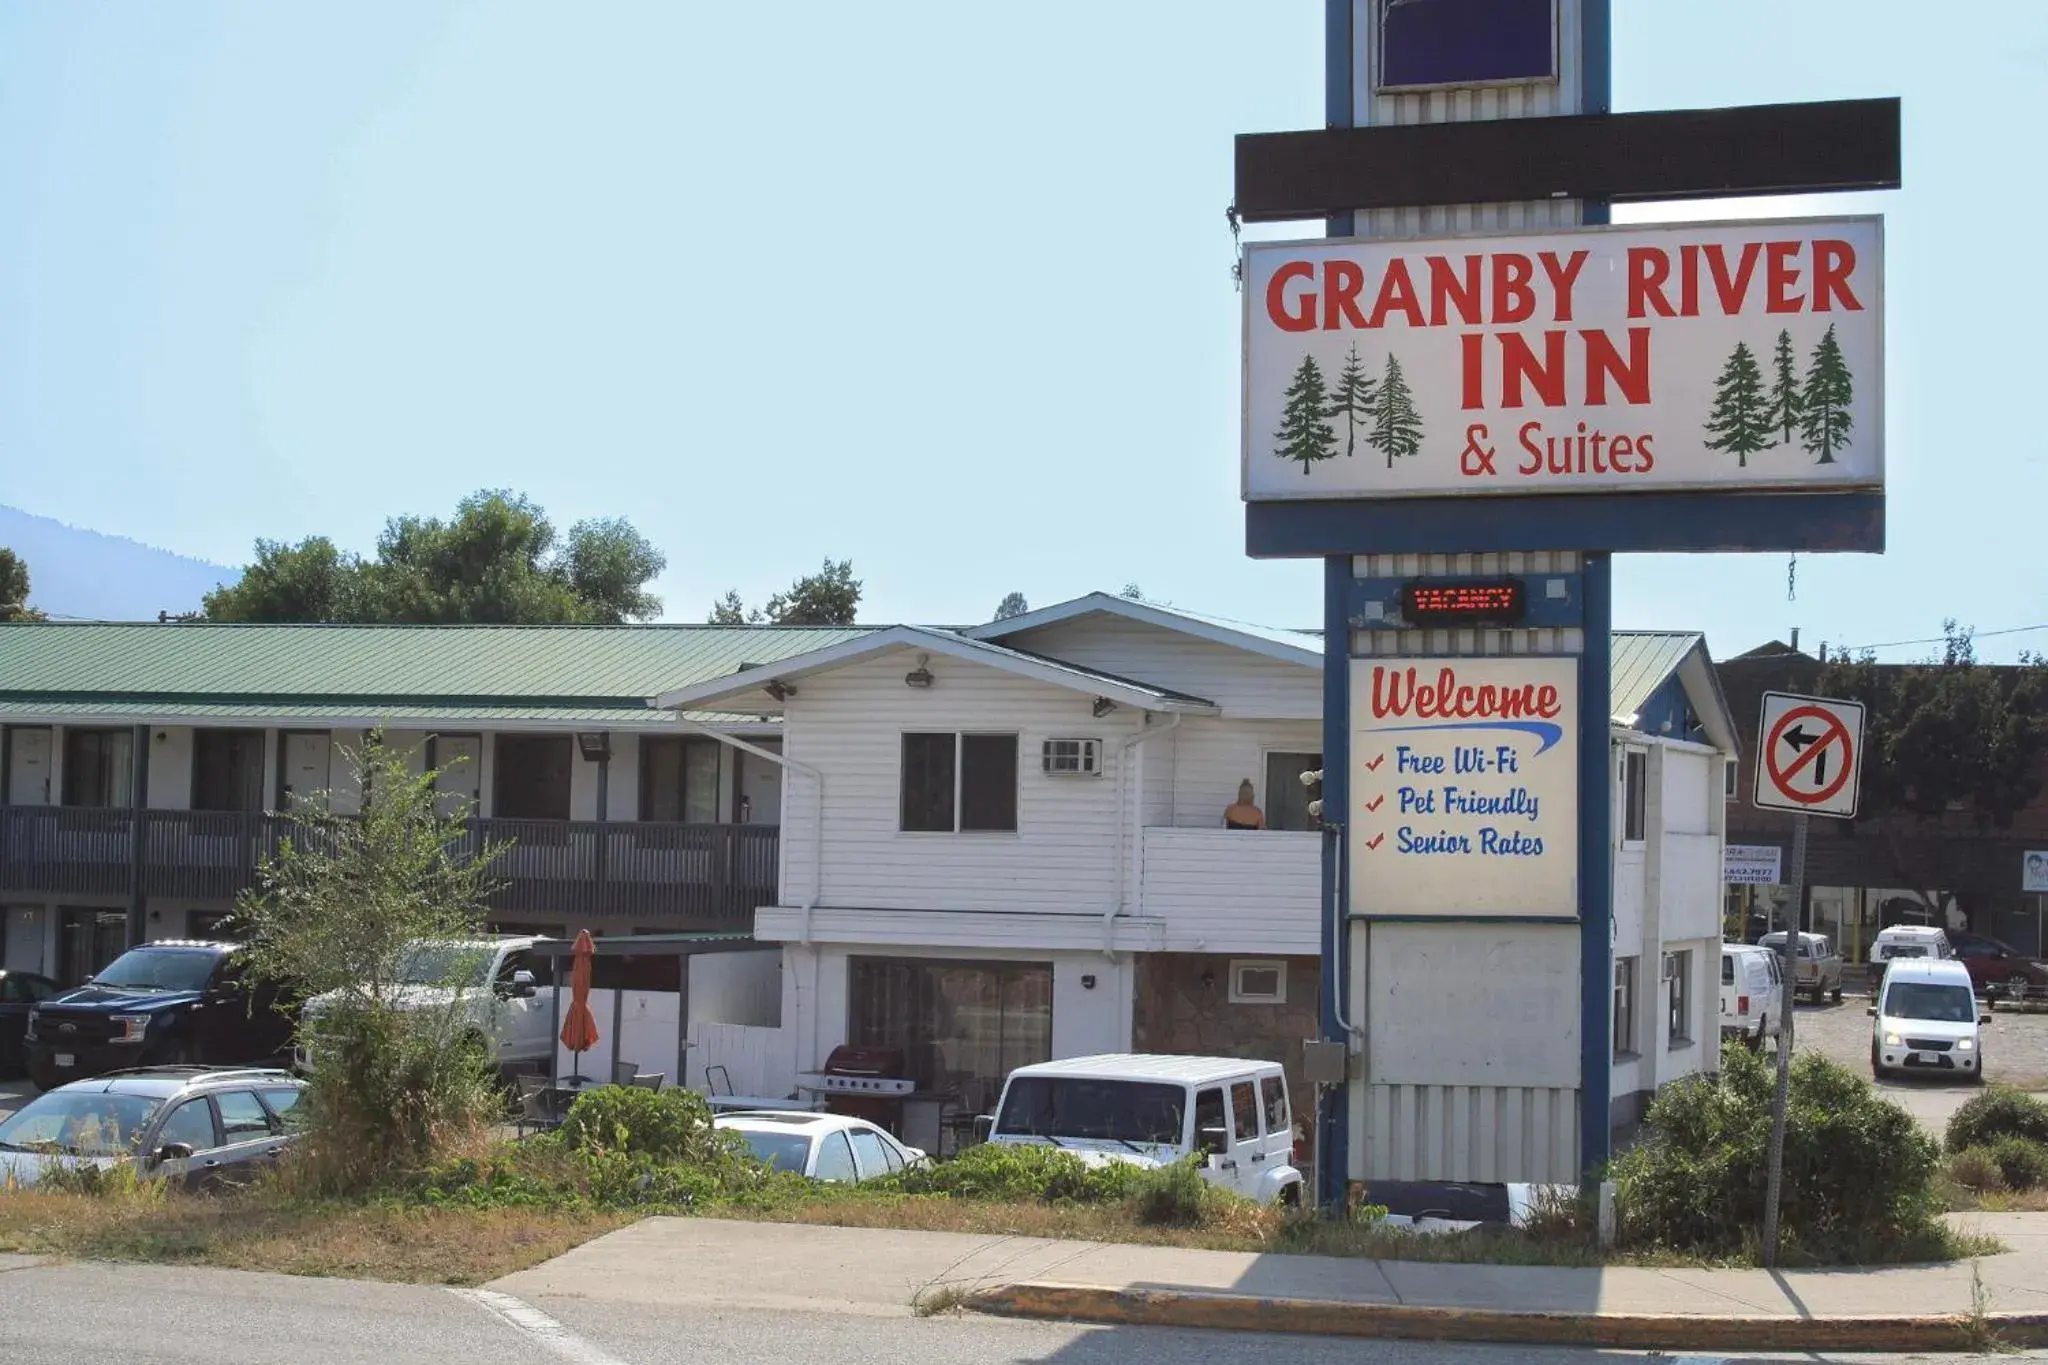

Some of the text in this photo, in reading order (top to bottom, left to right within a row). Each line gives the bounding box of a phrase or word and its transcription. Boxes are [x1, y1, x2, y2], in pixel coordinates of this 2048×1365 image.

[1266, 240, 1864, 332] GRANBY RIVER
[1460, 326, 1652, 411] INN
[1460, 420, 1654, 477] & Suites
[1414, 586, 1514, 610] VACANCY
[1371, 665, 1562, 719] Welcome
[1396, 746, 1519, 774] Free Wi-Fi
[1398, 786, 1539, 822] Pet Friendly
[1397, 826, 1544, 856] Senior Rates
